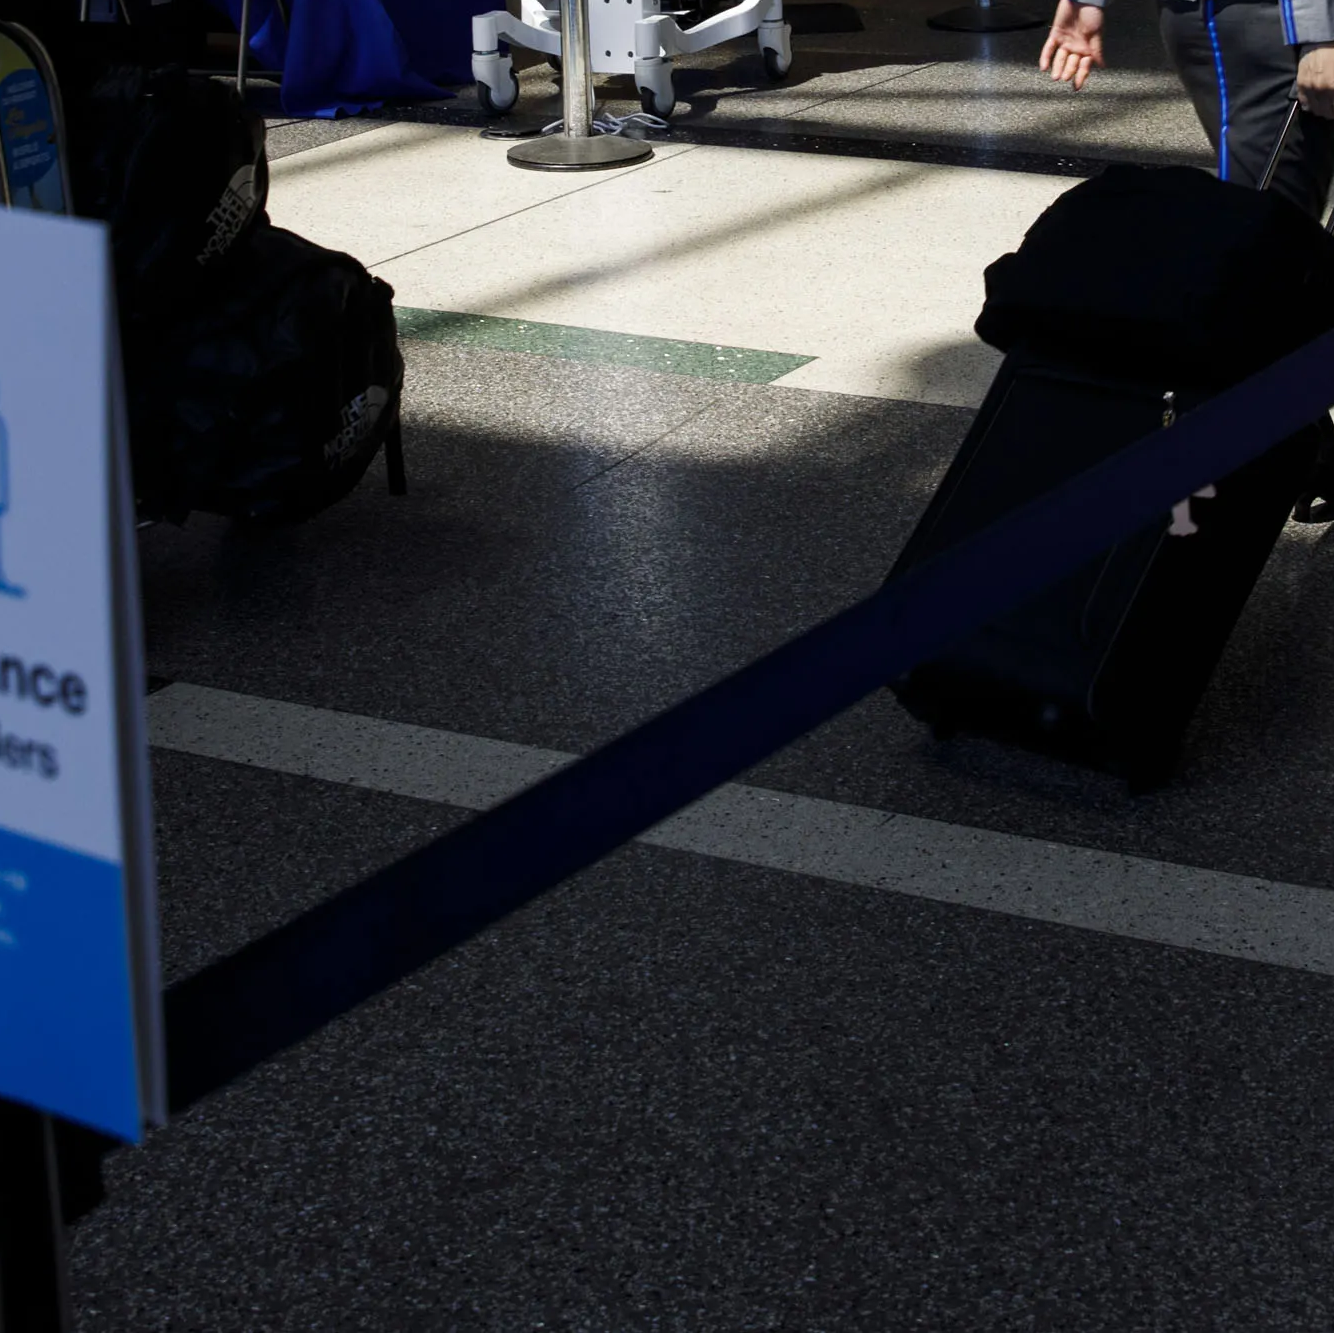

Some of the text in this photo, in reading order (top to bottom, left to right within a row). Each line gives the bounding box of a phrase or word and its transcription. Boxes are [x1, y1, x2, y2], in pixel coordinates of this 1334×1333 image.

[205, 187, 234, 225] THE
[195, 198, 247, 267] NORTH
[338, 391, 368, 427] THE
